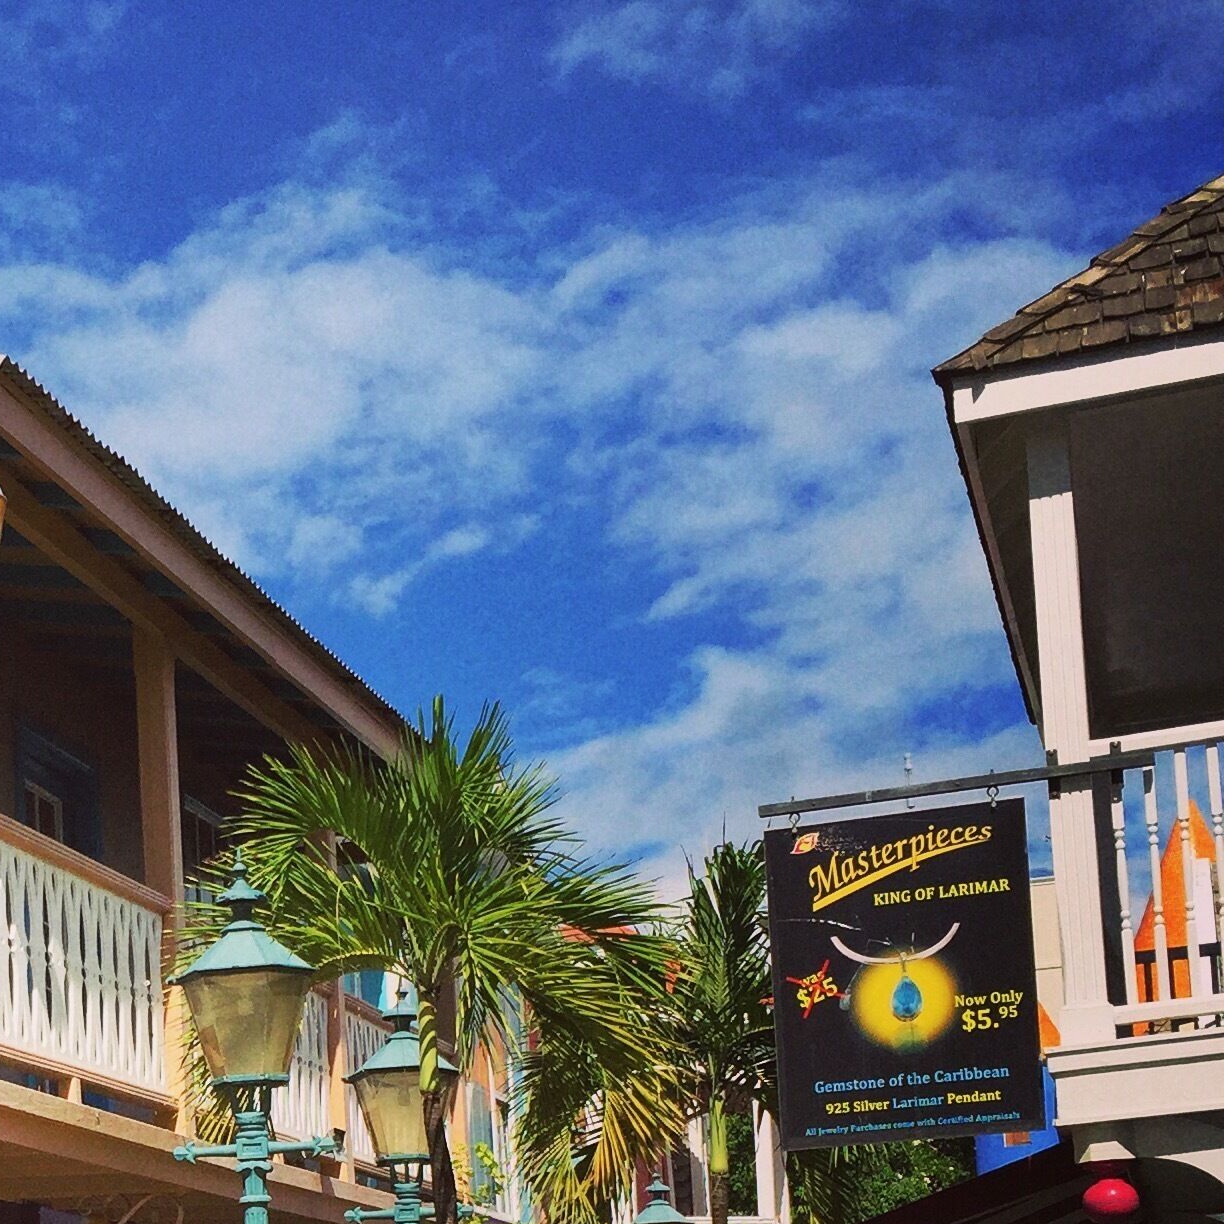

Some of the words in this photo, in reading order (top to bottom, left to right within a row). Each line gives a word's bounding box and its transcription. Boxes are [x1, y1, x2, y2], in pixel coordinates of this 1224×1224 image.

[809, 825, 992, 902] Masterpieces
[873, 890, 911, 906] KING
[915, 887, 935, 901] OF
[938, 878, 1011, 899] LARIMAR
[796, 976, 838, 1009] $25
[954, 994, 987, 1008] Now
[990, 989, 1024, 1005] Only
[814, 1077, 885, 1095] Gemstone
[889, 1073, 905, 1087] of
[907, 1071, 931, 1086] the
[934, 1066, 1010, 1083] Caribbean
[825, 1101, 851, 1115] 925
[853, 1099, 890, 1114] Silver
[892, 1095, 944, 1109] Larimar
[947, 1090, 1002, 1105] Pendant
[805, 1127, 817, 1137] All
[917, 1118, 936, 1127] with
[937, 1114, 974, 1126] Certified
[975, 1111, 1020, 1123] Appraisals
